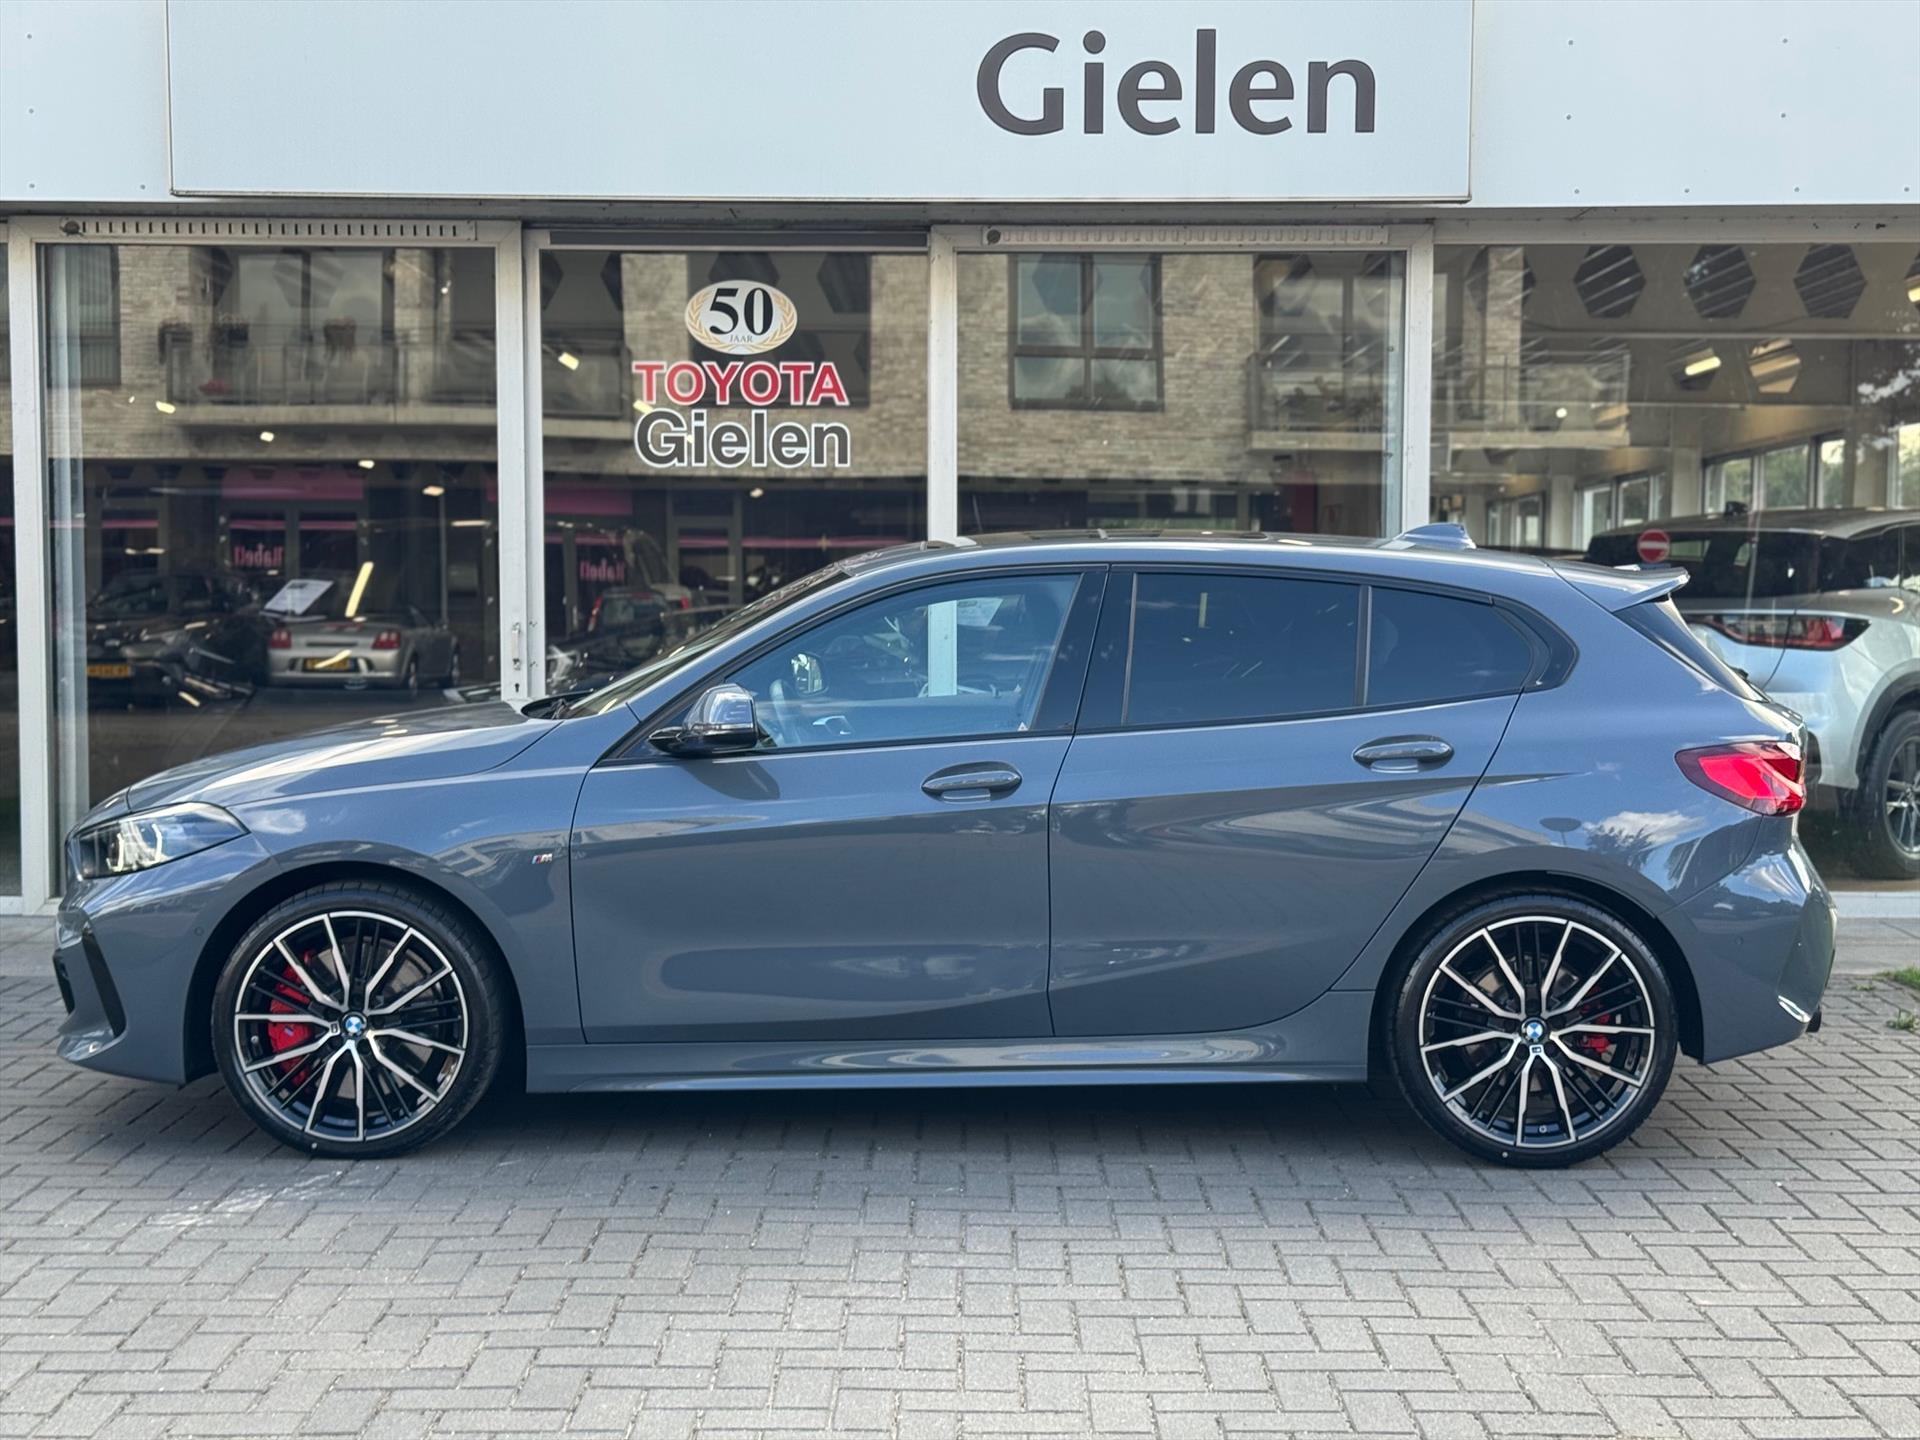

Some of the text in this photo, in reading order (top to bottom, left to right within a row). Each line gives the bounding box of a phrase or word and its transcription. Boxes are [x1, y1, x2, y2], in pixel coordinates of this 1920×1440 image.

[977, 29, 1376, 136] Gielen
[709, 287, 774, 336] 50
[728, 334, 754, 344] JAAR
[632, 361, 849, 405] TOYOTA
[634, 409, 851, 468] Gielen
